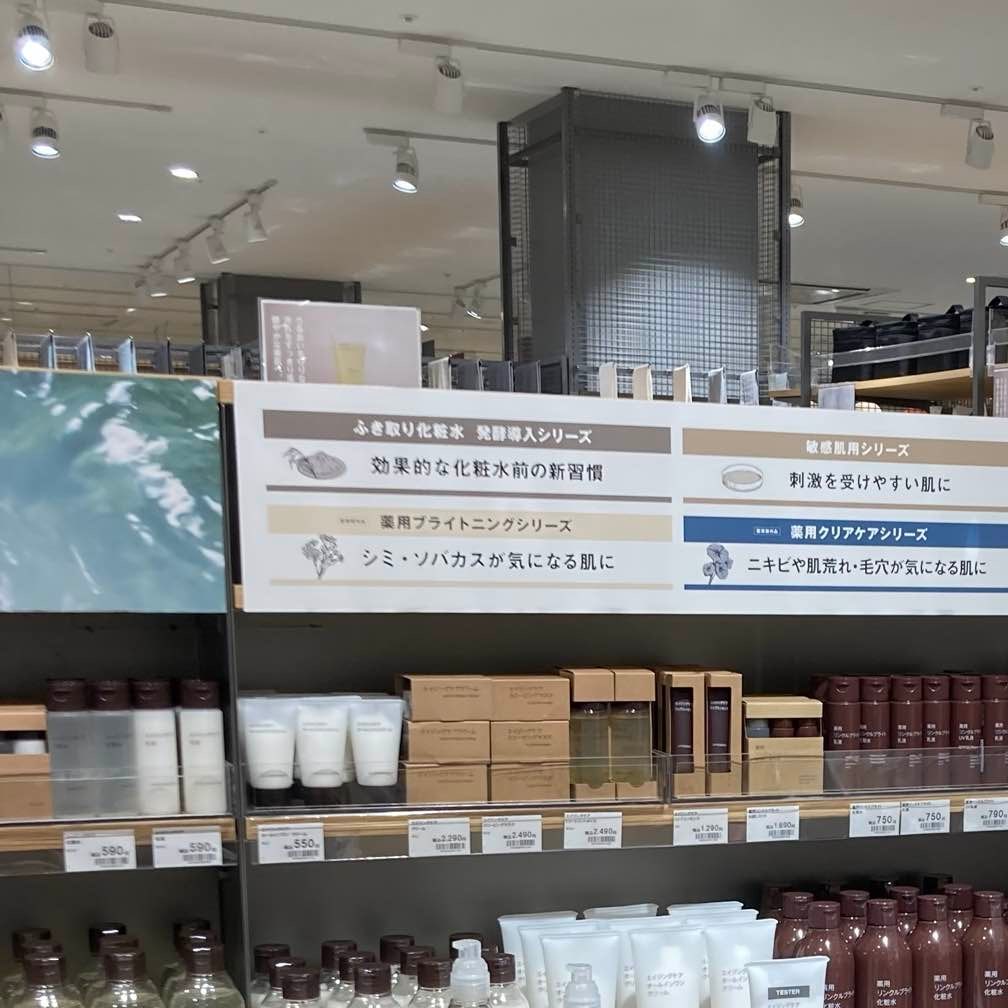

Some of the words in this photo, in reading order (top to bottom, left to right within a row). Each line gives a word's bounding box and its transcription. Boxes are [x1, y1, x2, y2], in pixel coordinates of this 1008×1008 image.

[353, 420, 465, 440] ふき取り化粧水
[477, 424, 593, 445] 発酵導入シリーズ
[806, 440, 910, 457] 敏感肌用シリーズ
[370, 456, 603, 482] 効果的な化粧水前の新習慣
[789, 472, 951, 493] 刺激を受けやすい肌に
[380, 514, 573, 533] 薬用ブライトニングシリーズ
[790, 525, 928, 541] 薬用クリアケアシリーズ
[362, 548, 615, 571] シミ・ソバカスが気になる肌に
[748, 556, 987, 577] ニキビや肌荒れ・毛穴が気になる肌に
[647, 972, 684, 981] エイジングケア
[934, 974, 947, 982] 薬用
[984, 970, 998, 978] 薬用
[876, 980, 891, 988] 薬用
[933, 992, 952, 1001] 化粧水
[984, 988, 1004, 997] 化粧水
[876, 998, 897, 1007] 化粧水
